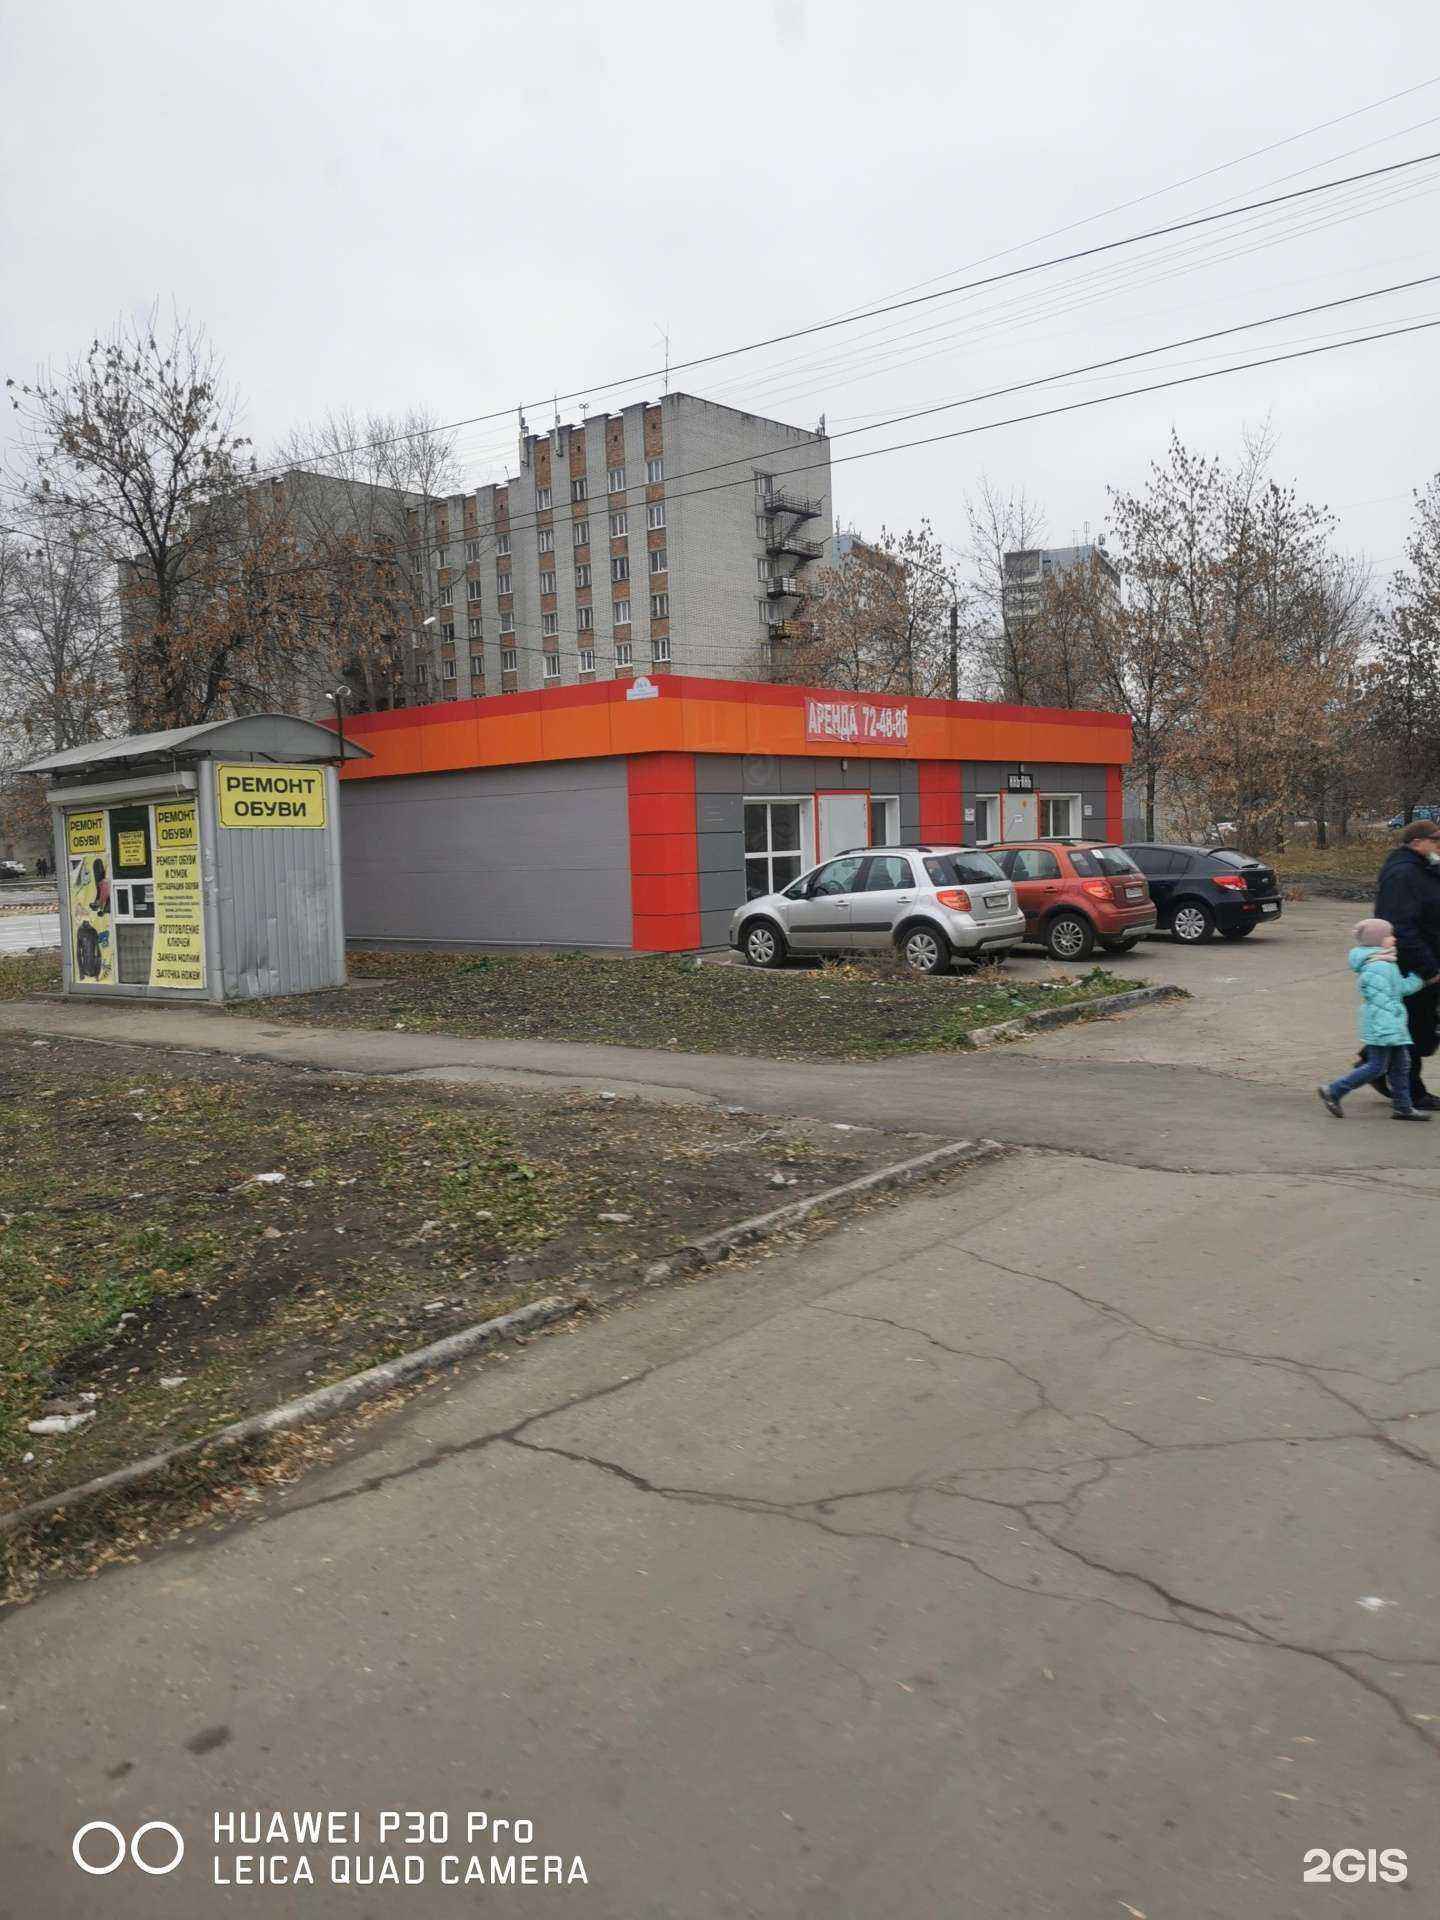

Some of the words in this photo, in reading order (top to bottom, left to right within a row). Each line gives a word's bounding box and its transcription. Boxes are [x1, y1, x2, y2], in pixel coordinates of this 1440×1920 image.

[808, 702, 858, 740] АРЕНДА
[226, 776, 315, 794] РЕМОНТ
[234, 801, 307, 817] ОБУВИ
[158, 809, 196, 823] РЕМОНТ
[70, 818, 103, 832] РЕМОНТ
[161, 827, 193, 841] ОБУВИ
[73, 835, 101, 848] ОБУВИ
[156, 855, 177, 866] РЕМОНТ
[179, 854, 197, 865] ОБУВИ
[158, 924, 200, 935] ИЗГОТОВЛЕНИЕ
[167, 935, 190, 947] КЛЮЧЕЙ
[156, 952, 177, 962] ЗАМЕНА
[155, 968, 180, 979] ЗАТОЧКА
